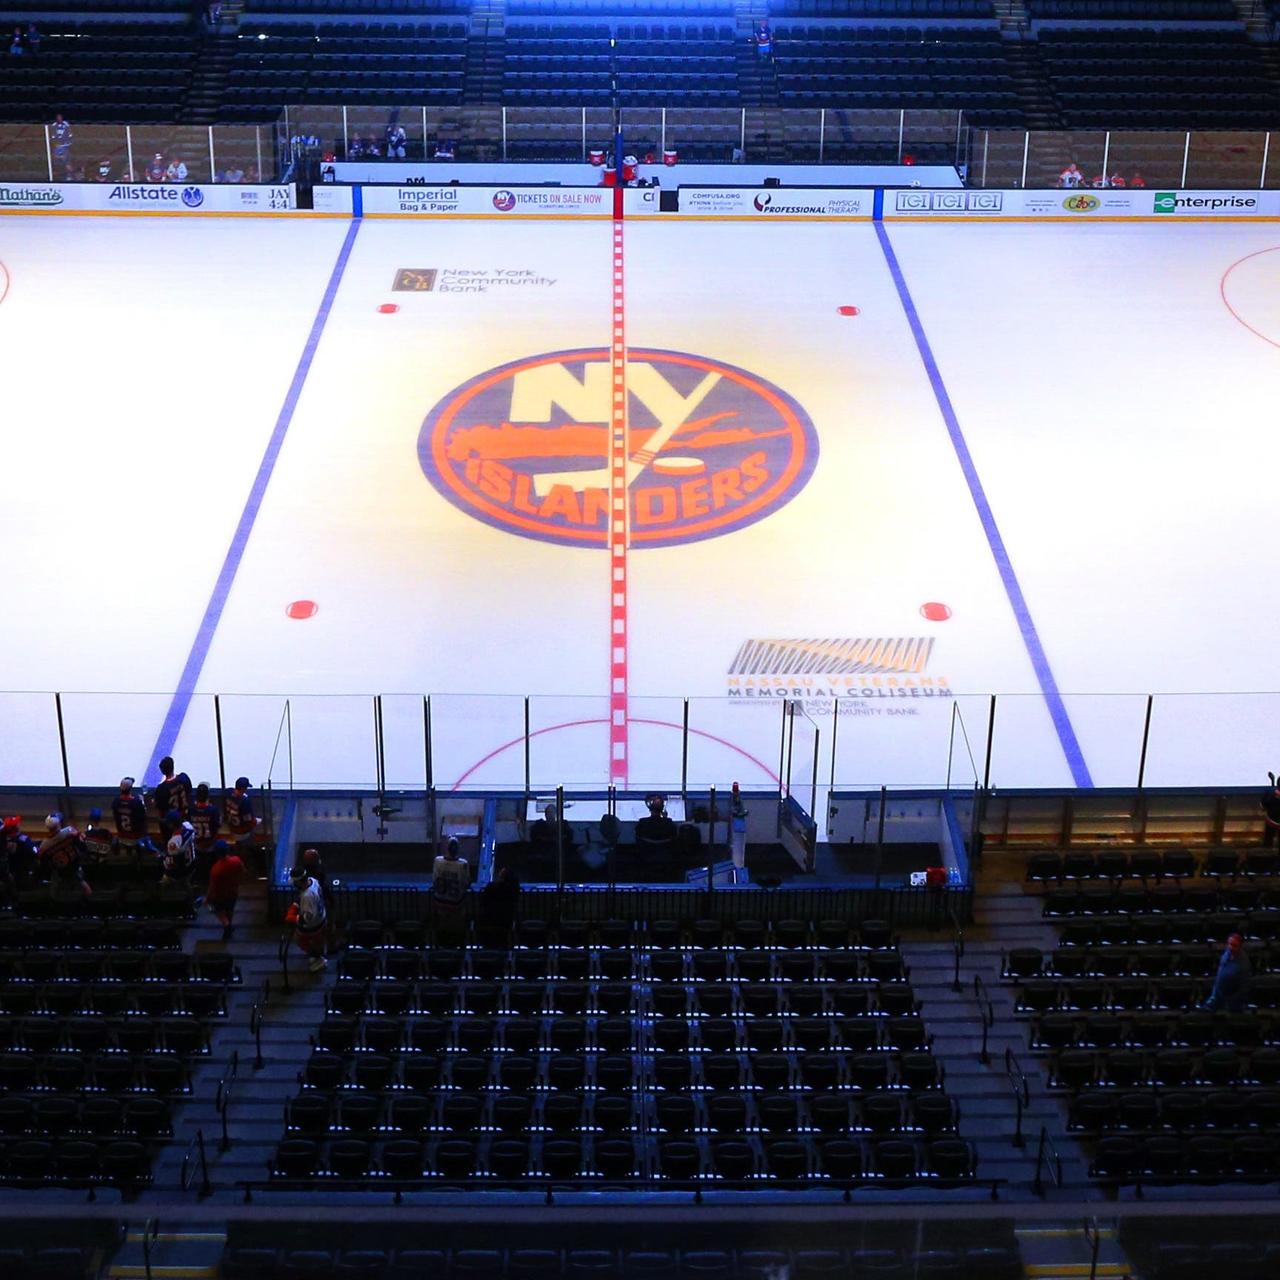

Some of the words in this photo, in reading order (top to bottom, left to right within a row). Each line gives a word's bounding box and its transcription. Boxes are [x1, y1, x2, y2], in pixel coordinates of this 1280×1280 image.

[109, 186, 178, 200] Allstate
[398, 189, 457, 202] Imperial
[517, 193, 548, 204] TICKETS
[549, 193, 561, 204] ON
[562, 193, 582, 204] SALE
[583, 193, 602, 204] NOW
[900, 194, 927, 208] TGI
[936, 194, 964, 208] TGI
[971, 194, 999, 208] TGI
[1160, 195, 1256, 210] enterprise
[400, 203, 419, 211] Bag
[430, 203, 458, 211] Paper
[443, 268, 490, 277] New
[494, 268, 537, 277] York
[440, 276, 557, 287] Community
[439, 284, 488, 293] Bank
[464, 448, 771, 526] ISLANDERS
[727, 677, 814, 687] NASSAU
[827, 677, 951, 688] VETERANS
[728, 688, 839, 697] MEMORIAL
[847, 687, 953, 698] COLISEUM
[805, 700, 833, 708] NEW
[839, 700, 869, 708] YORK
[806, 707, 882, 716] COMMUNITY
[886, 707, 920, 716] BANK
